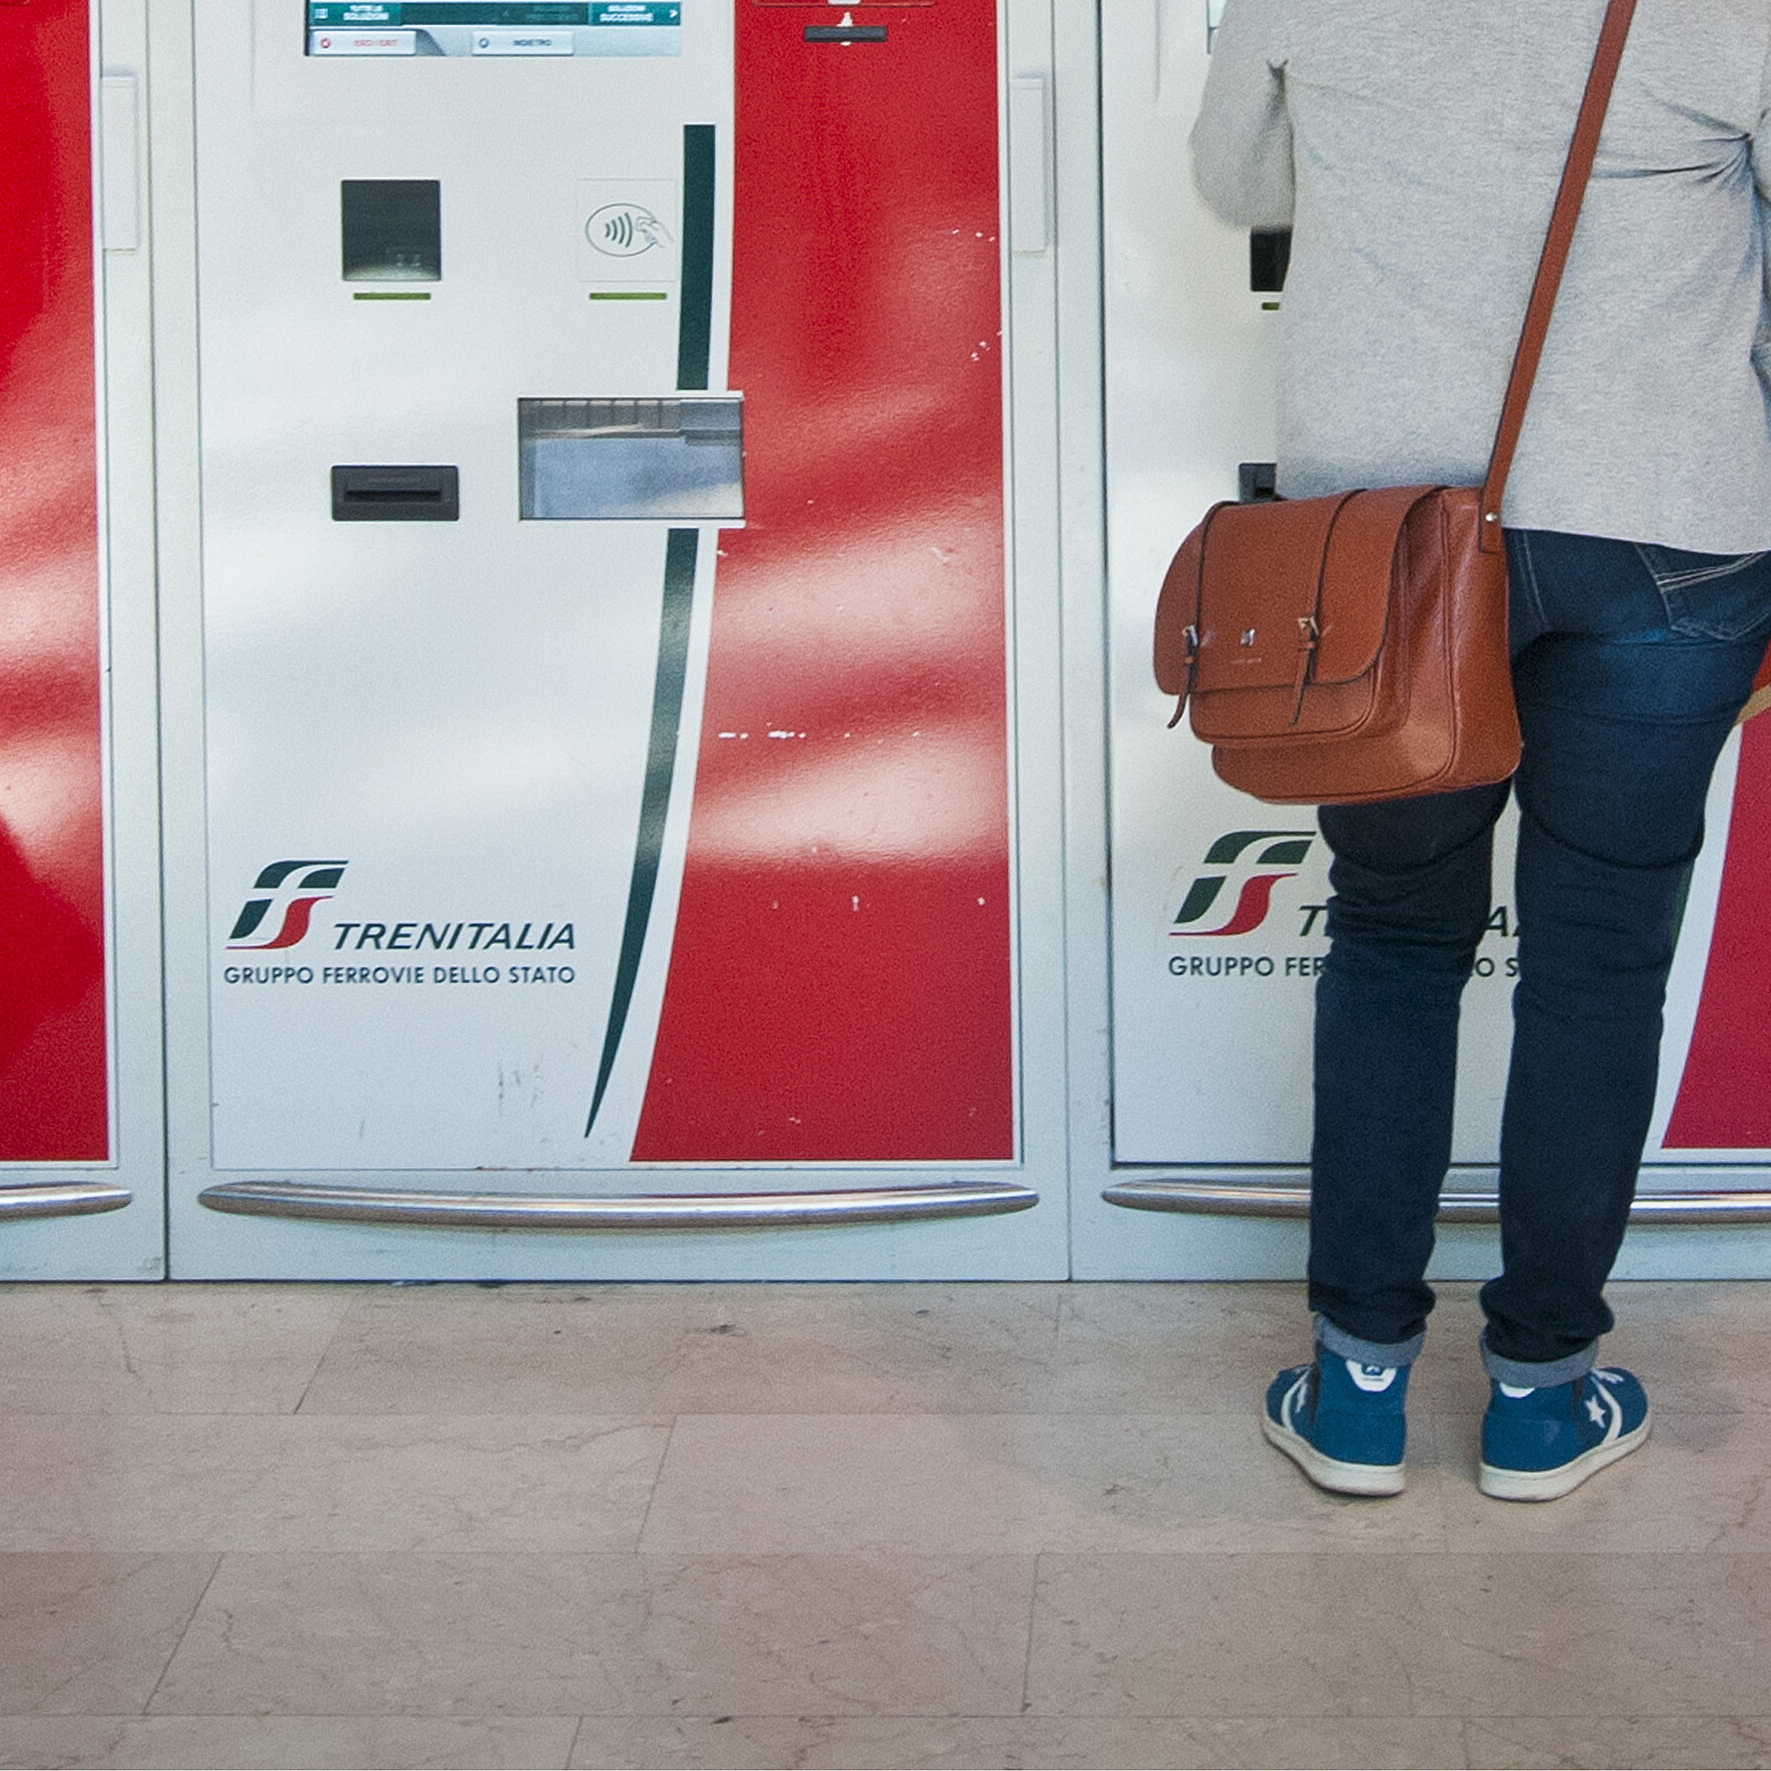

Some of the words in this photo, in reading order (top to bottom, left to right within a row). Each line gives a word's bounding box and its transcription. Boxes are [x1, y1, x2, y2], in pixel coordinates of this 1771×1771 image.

[333, 922, 575, 950] TRENITALIA
[224, 966, 314, 984] GRUPPO
[323, 966, 424, 984] FERROVIE
[434, 966, 500, 984] DELLO
[509, 966, 575, 984] STATO
[1168, 955, 1275, 977] GRUPPO
